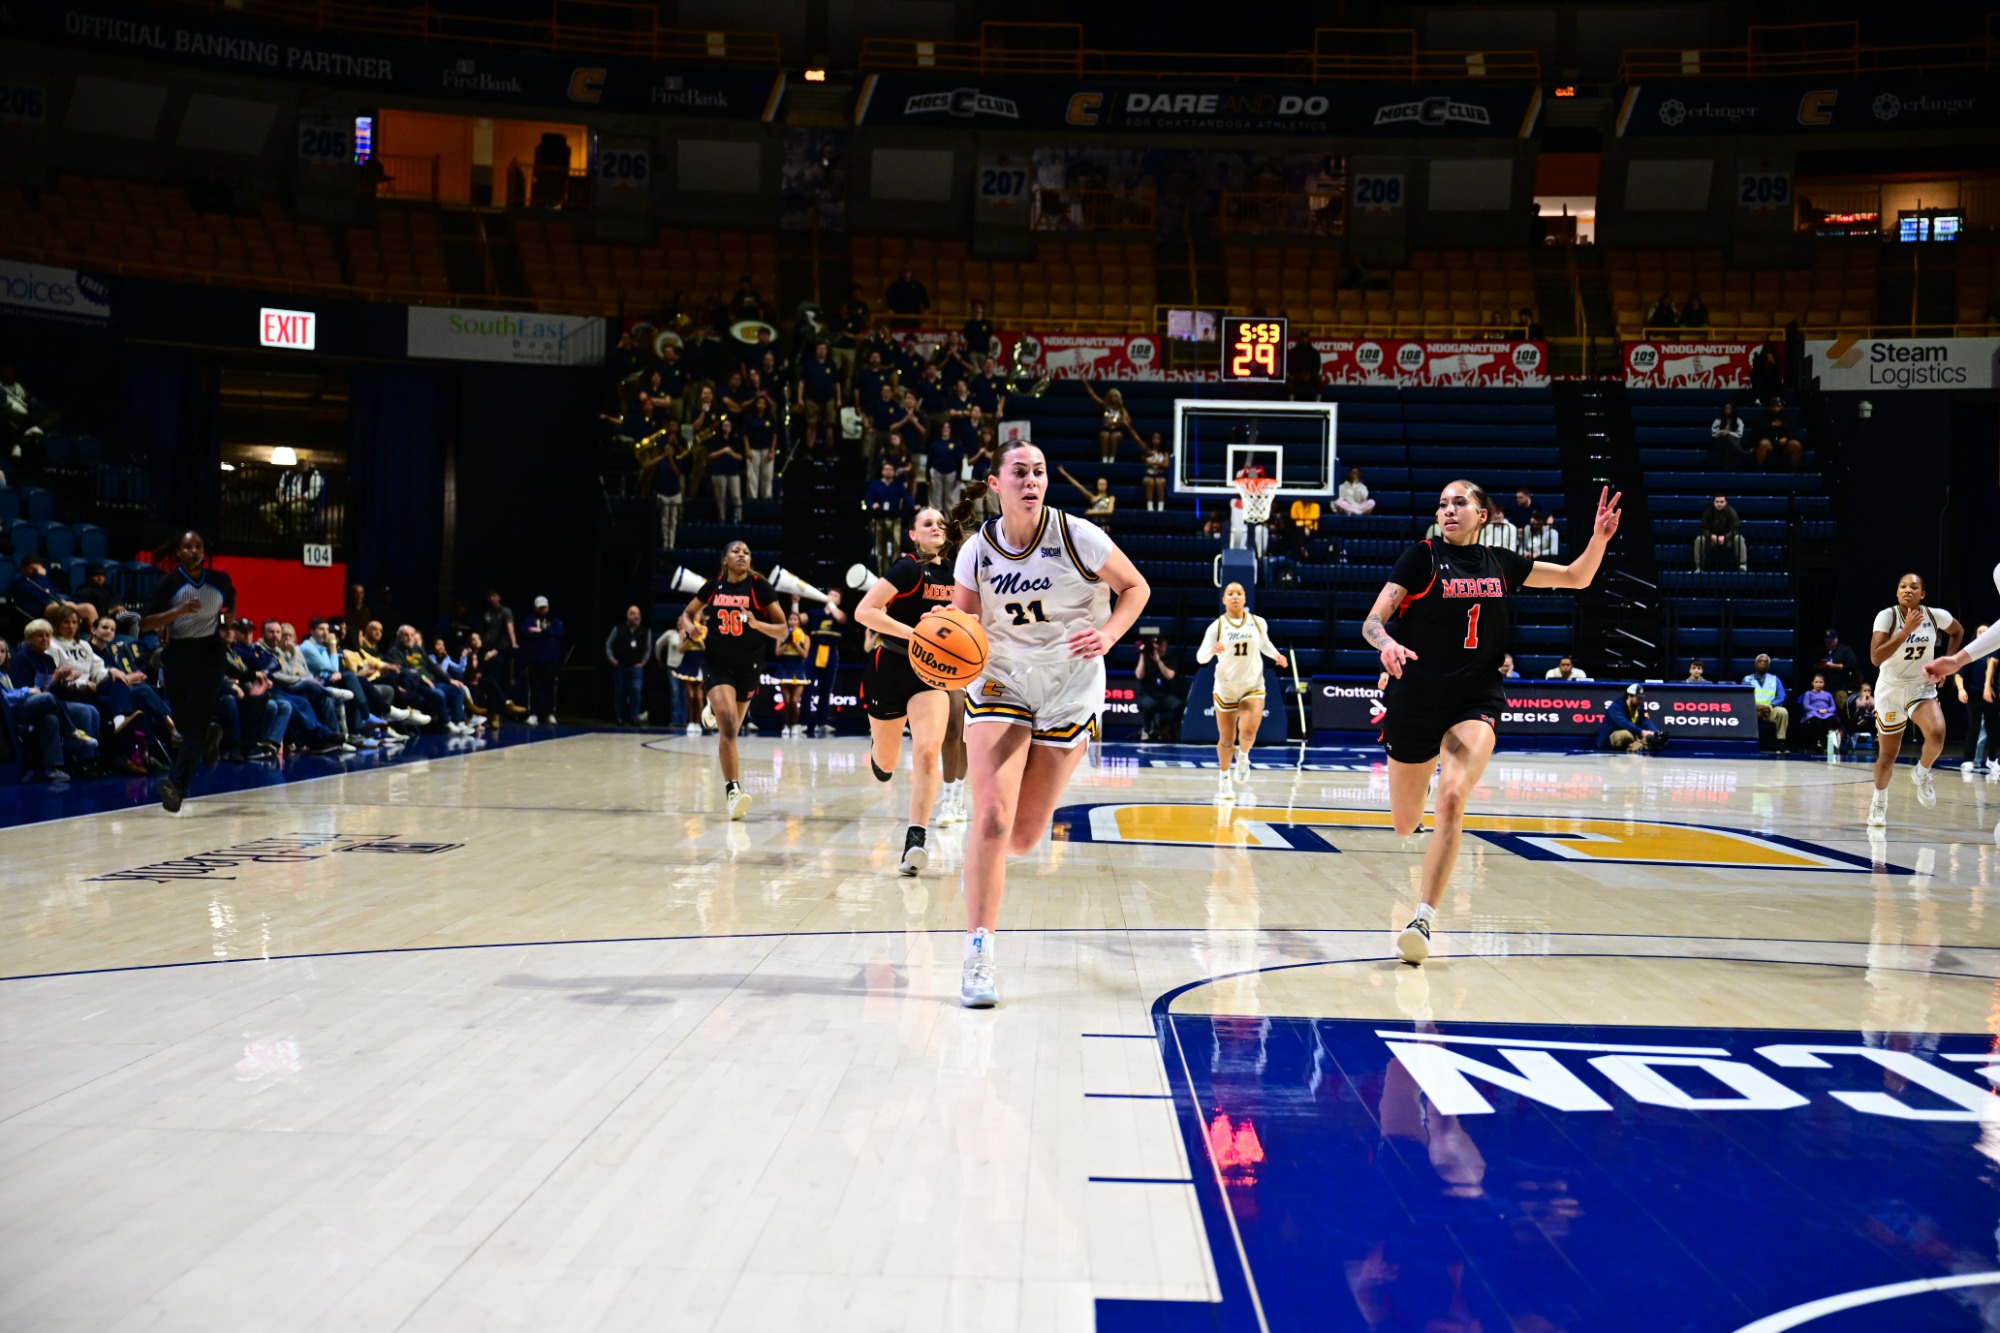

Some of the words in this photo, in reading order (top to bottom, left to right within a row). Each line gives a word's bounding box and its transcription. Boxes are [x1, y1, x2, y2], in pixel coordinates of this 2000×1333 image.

[65, 11, 167, 50] OFFICIAL
[175, 29, 279, 66] BANKING
[287, 46, 393, 81] PARTNER
[442, 68, 523, 94] FirstBank
[651, 85, 728, 107] FirstBank
[1903, 95, 1977, 113] erlanger
[1688, 102, 1760, 121] erlanger
[1126, 117, 1151, 128] FOR
[1157, 118, 1251, 129] CHATTANOOGA
[1257, 120, 1328, 130] ATHLETICS
[302, 129, 347, 159] 205
[603, 152, 647, 181] 206
[982, 170, 1025, 197] 207
[1357, 177, 1401, 204] 208
[1742, 175, 1788, 203] 209
[264, 313, 311, 345] EXIT
[448, 314, 567, 339] SouthEast
[1239, 322, 1280, 344] 5:53
[1232, 342, 1275, 376] 29
[1426, 343, 1511, 353] NOOGANATION
[1516, 350, 1537, 360] 108
[1634, 351, 1655, 362] 109
[1661, 344, 1747, 355] NOOGANATION
[1870, 342, 1948, 364] Steam
[1870, 363, 1967, 389] Logistics
[306, 546, 330, 564] 104
[990, 571, 1053, 595] Mocs
[1441, 577, 1503, 598] MERCER
[717, 608, 743, 637] 30
[1004, 599, 1050, 626] 21
[1227, 632, 1253, 640] Mocs
[1463, 603, 1481, 649] 1
[911, 640, 958, 676] Wilson
[1233, 642, 1248, 656] 11
[1904, 646, 1927, 661] 23
[1507, 699, 1591, 710] WINDOWS
[1673, 701, 1732, 713] DOORS
[1501, 712, 1560, 723] DECKS
[1664, 716, 1739, 726] ROOFING
